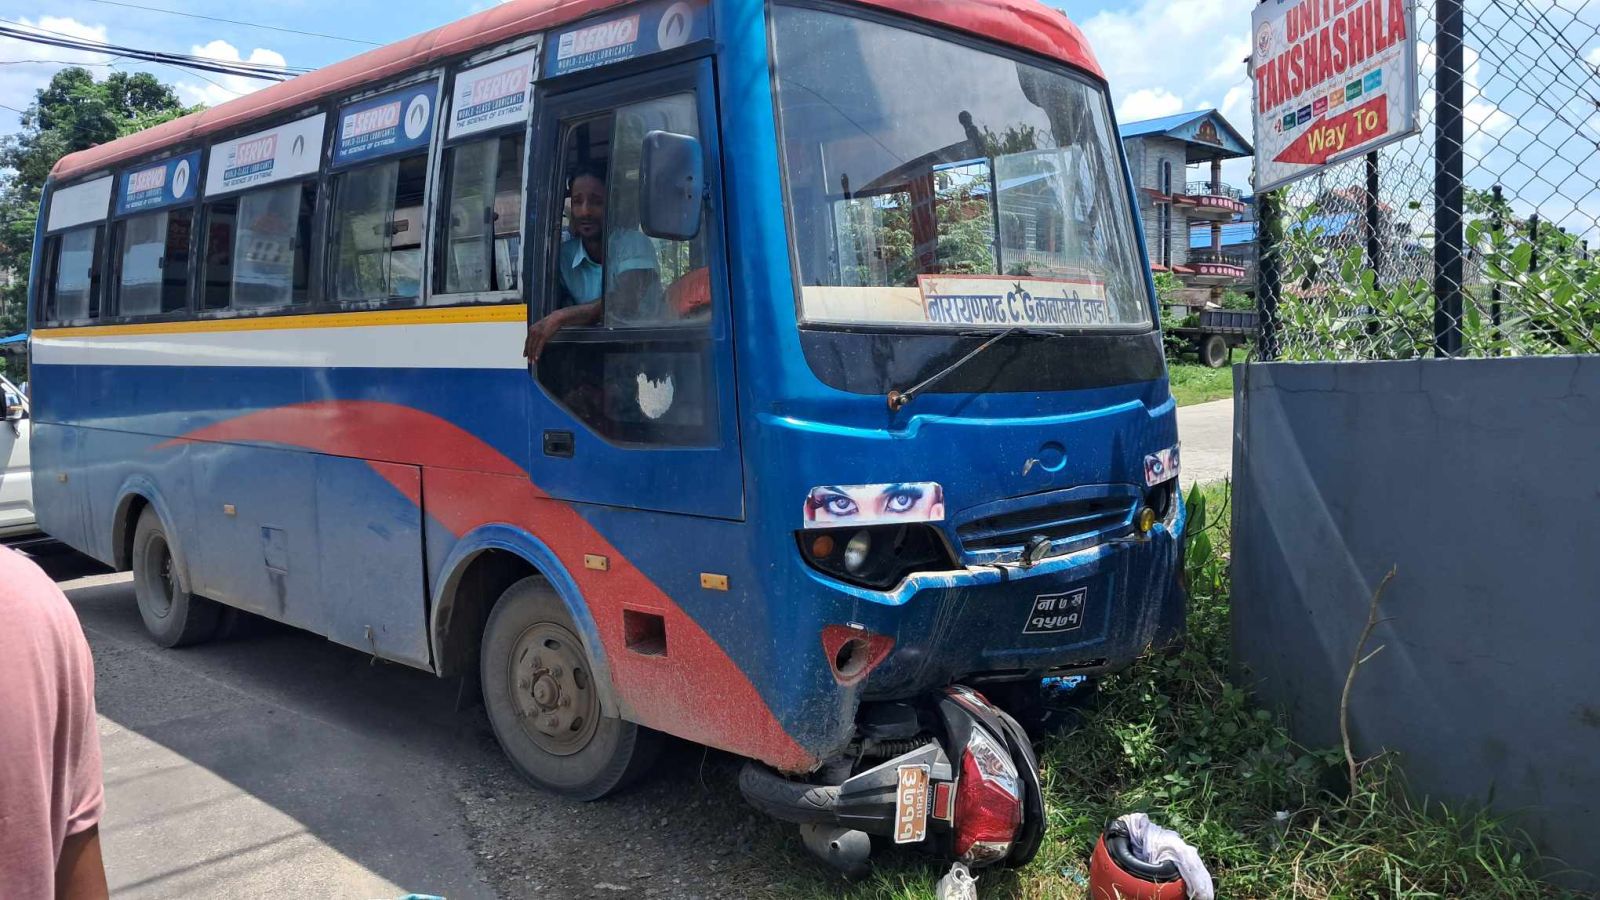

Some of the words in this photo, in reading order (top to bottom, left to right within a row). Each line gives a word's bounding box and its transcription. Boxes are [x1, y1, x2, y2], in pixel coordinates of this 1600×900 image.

[579, 20, 632, 50] SERVO
[597, 43, 633, 59] LUBRICANTS
[1256, 0, 1406, 113] TAKSHASHILA
[478, 70, 522, 99] SERVO
[358, 105, 395, 134] SERVO
[1308, 122, 1347, 154] Way
[1353, 108, 1378, 135] To
[240, 137, 273, 161] SERVO
[1037, 599, 1057, 610] ना
[1059, 598, 1068, 609] ७
[1032, 613, 1078, 628] १५७१
